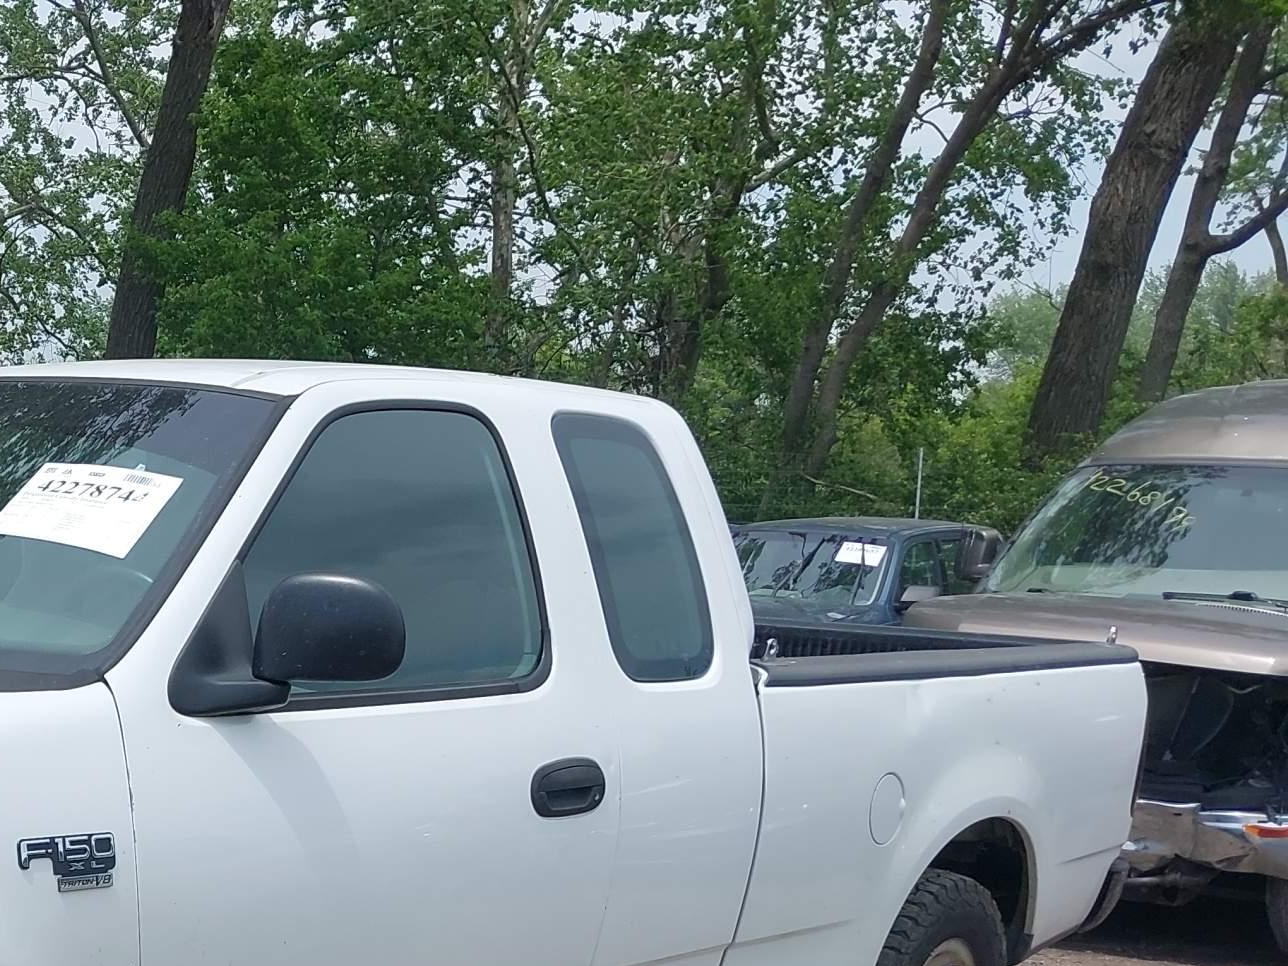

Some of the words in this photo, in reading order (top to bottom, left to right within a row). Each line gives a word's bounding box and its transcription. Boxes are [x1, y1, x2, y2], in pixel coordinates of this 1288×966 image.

[19, 833, 115, 868] F-150
[67, 860, 105, 872] XL
[61, 877, 93, 888] TRITON
[92, 875, 111, 887] V8
